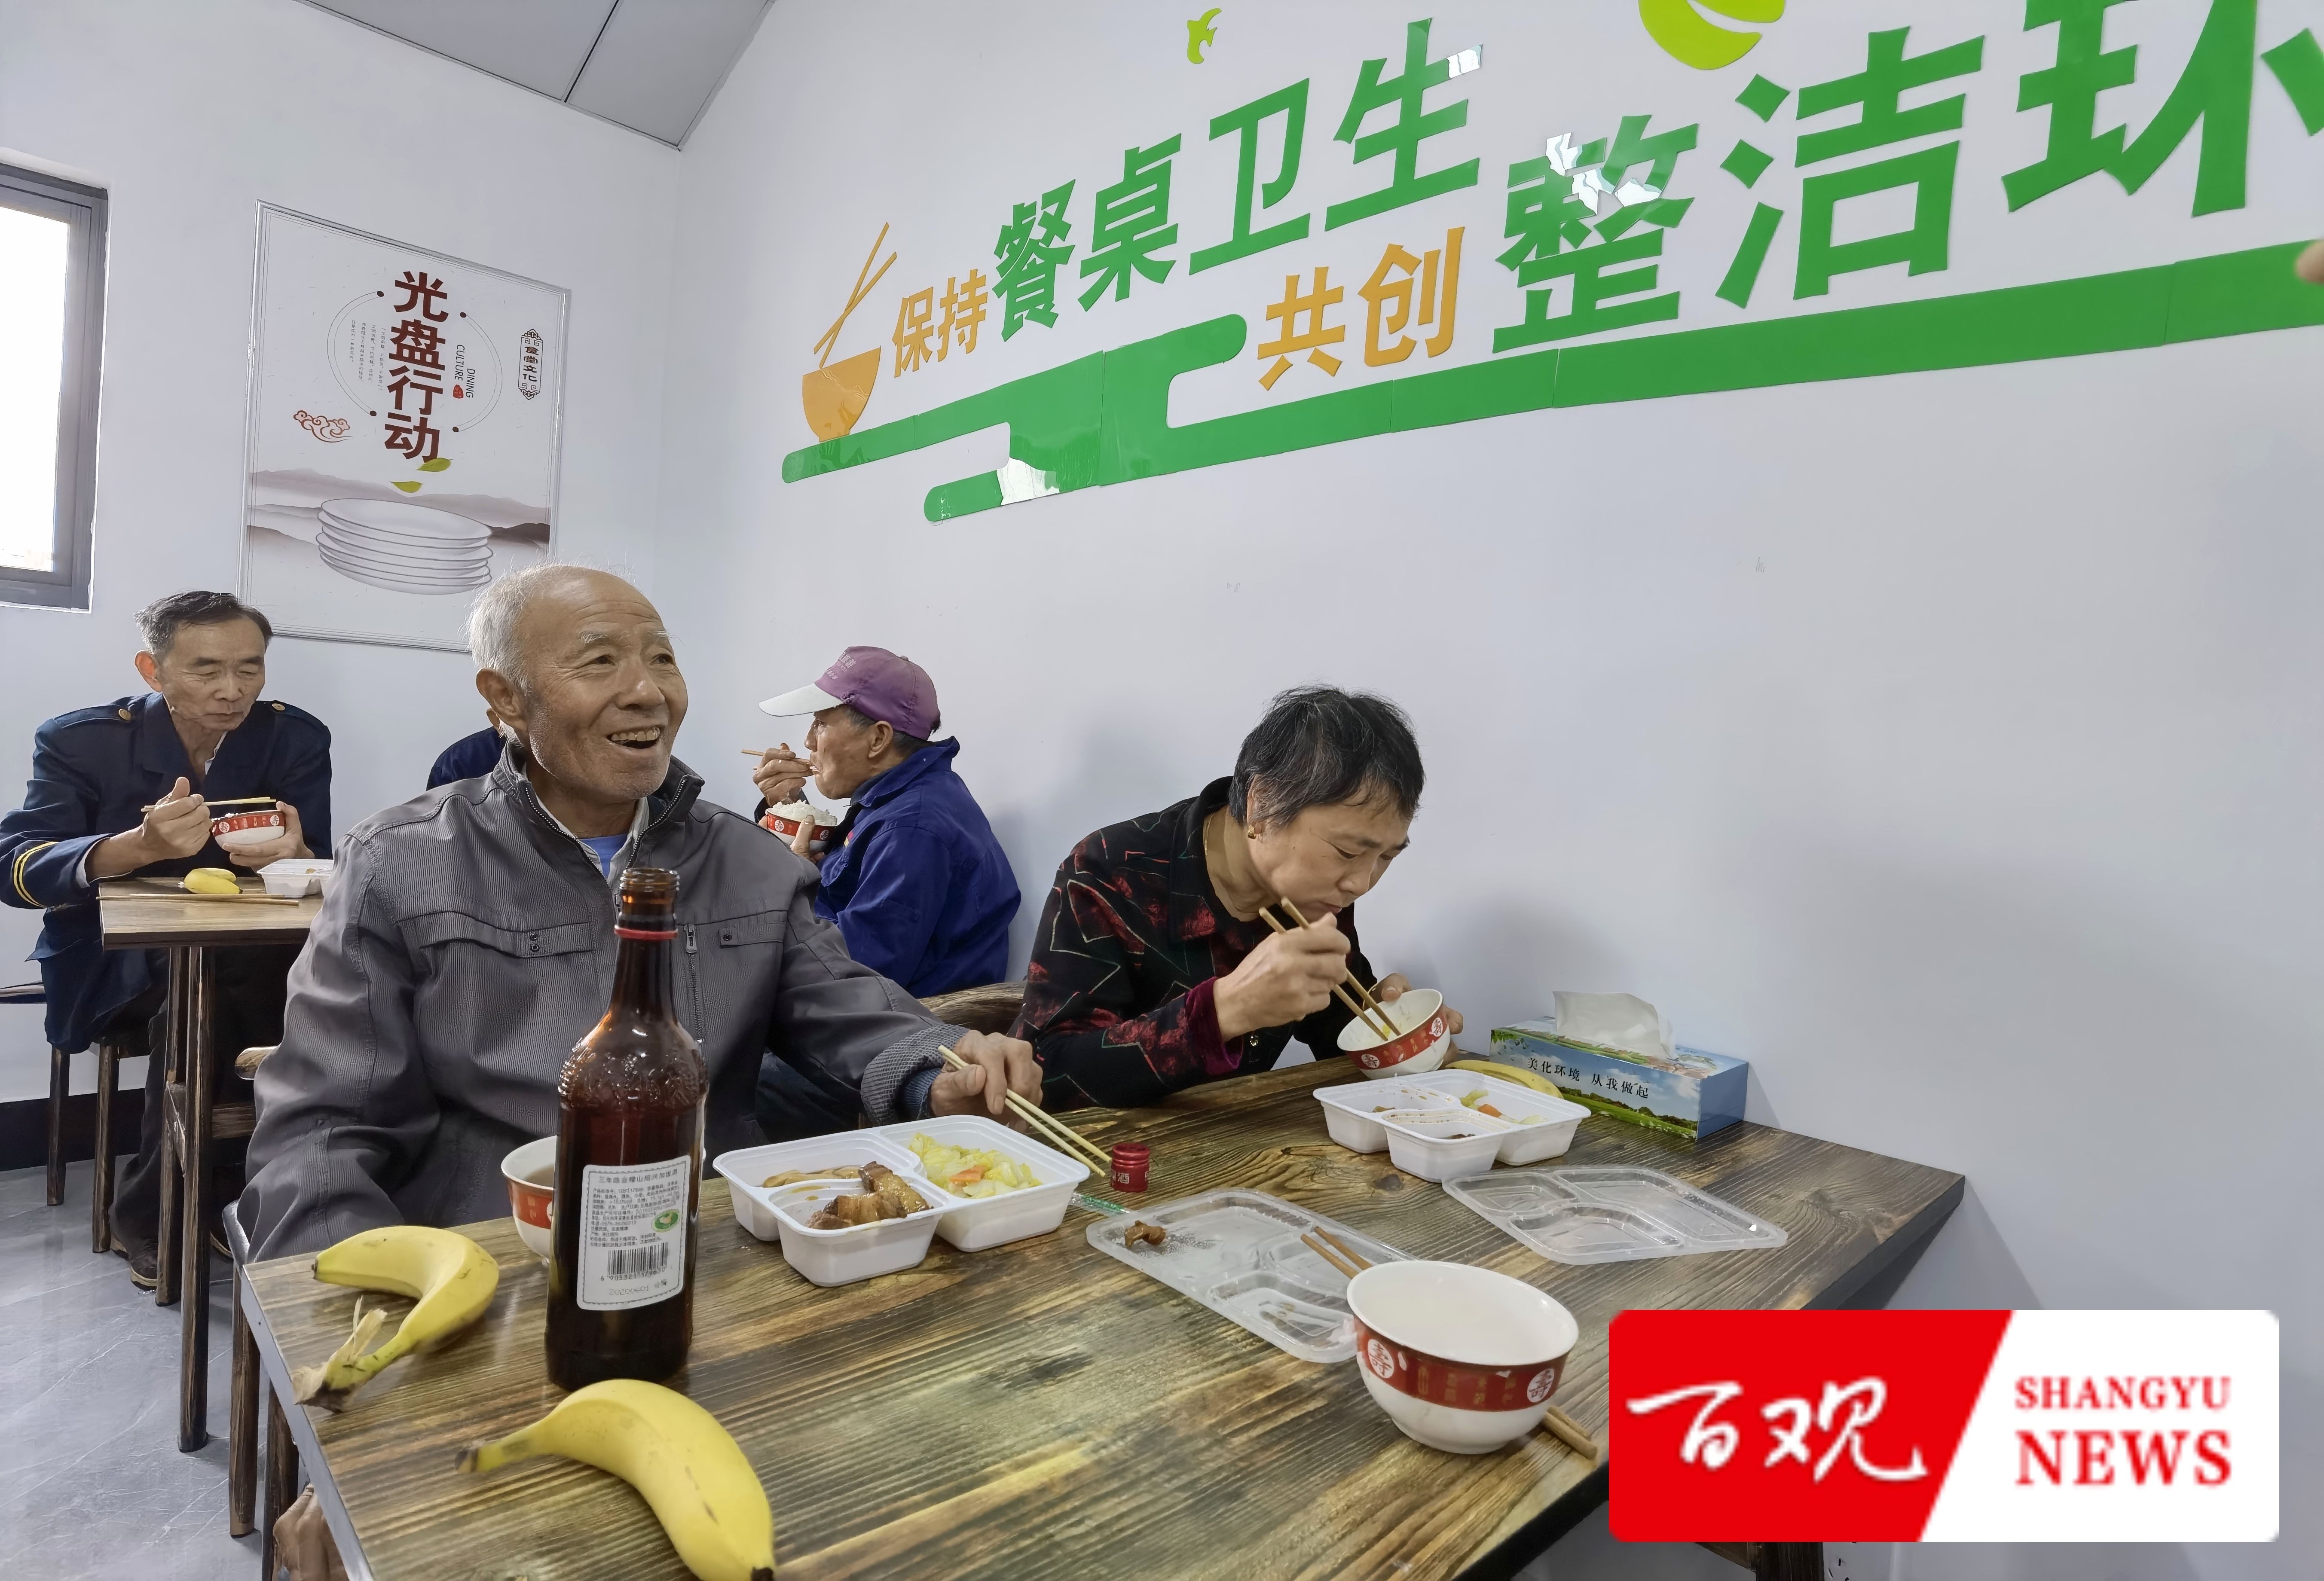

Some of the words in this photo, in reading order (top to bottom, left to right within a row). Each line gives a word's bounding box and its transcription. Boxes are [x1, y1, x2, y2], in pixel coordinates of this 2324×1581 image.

[892, 269, 988, 378] 保持
[992, 18, 1483, 342] 餐桌卫生
[1257, 227, 1464, 391] 共创
[384, 271, 448, 463] 光盘行动
[455, 345, 465, 381] CULTURE
[466, 368, 475, 398] DINING
[1528, 1058, 1580, 1081] 美化环境
[1591, 1074, 1648, 1099] 从我做起
